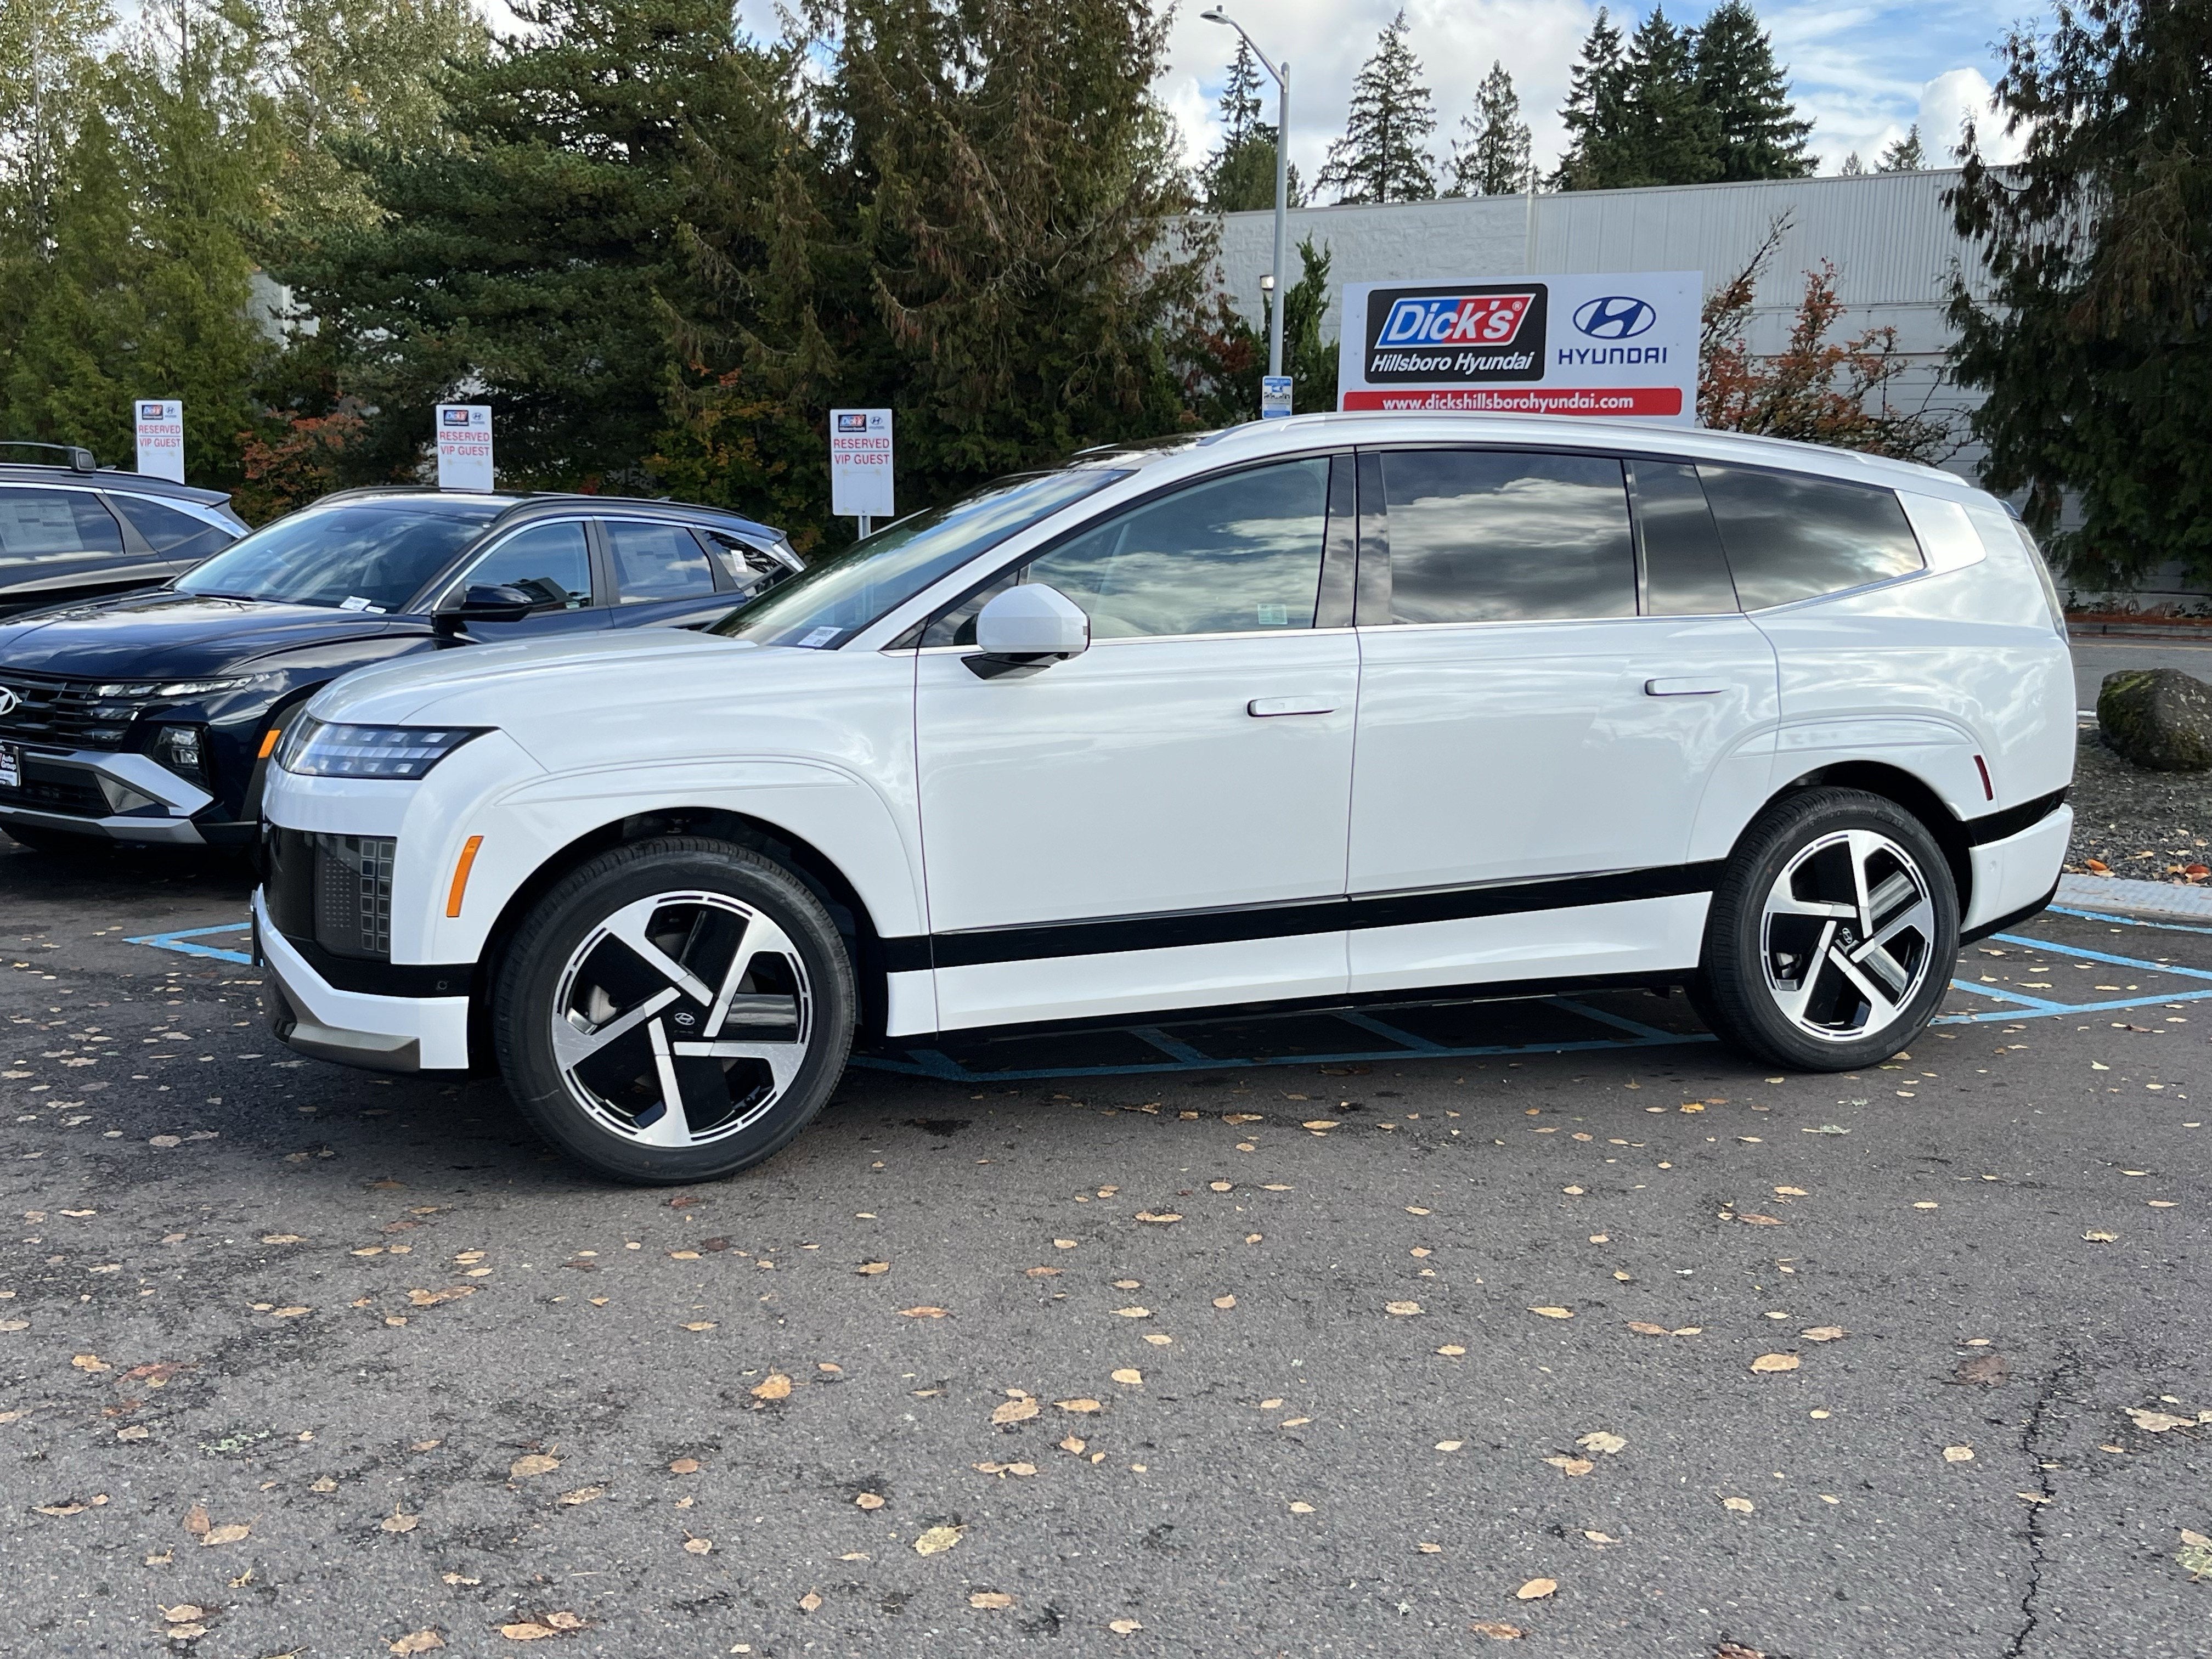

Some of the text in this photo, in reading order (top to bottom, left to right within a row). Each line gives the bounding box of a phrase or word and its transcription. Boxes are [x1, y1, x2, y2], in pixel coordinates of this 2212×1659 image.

[1387, 301, 1515, 341] Dick's
[1558, 347, 1667, 365] HYUNDAI
[1370, 352, 1535, 375] Hillsboro Hyundai
[1382, 391, 1634, 414] www.dickshillsborohyundai.com
[138, 425, 181, 435] RESERVED
[439, 431, 490, 442] RESERVED
[139, 438, 181, 448] VIP GUEST
[834, 438, 889, 449] RESERVED
[441, 445, 490, 456] VIP GUEST
[834, 454, 889, 465] VIP GUEST
